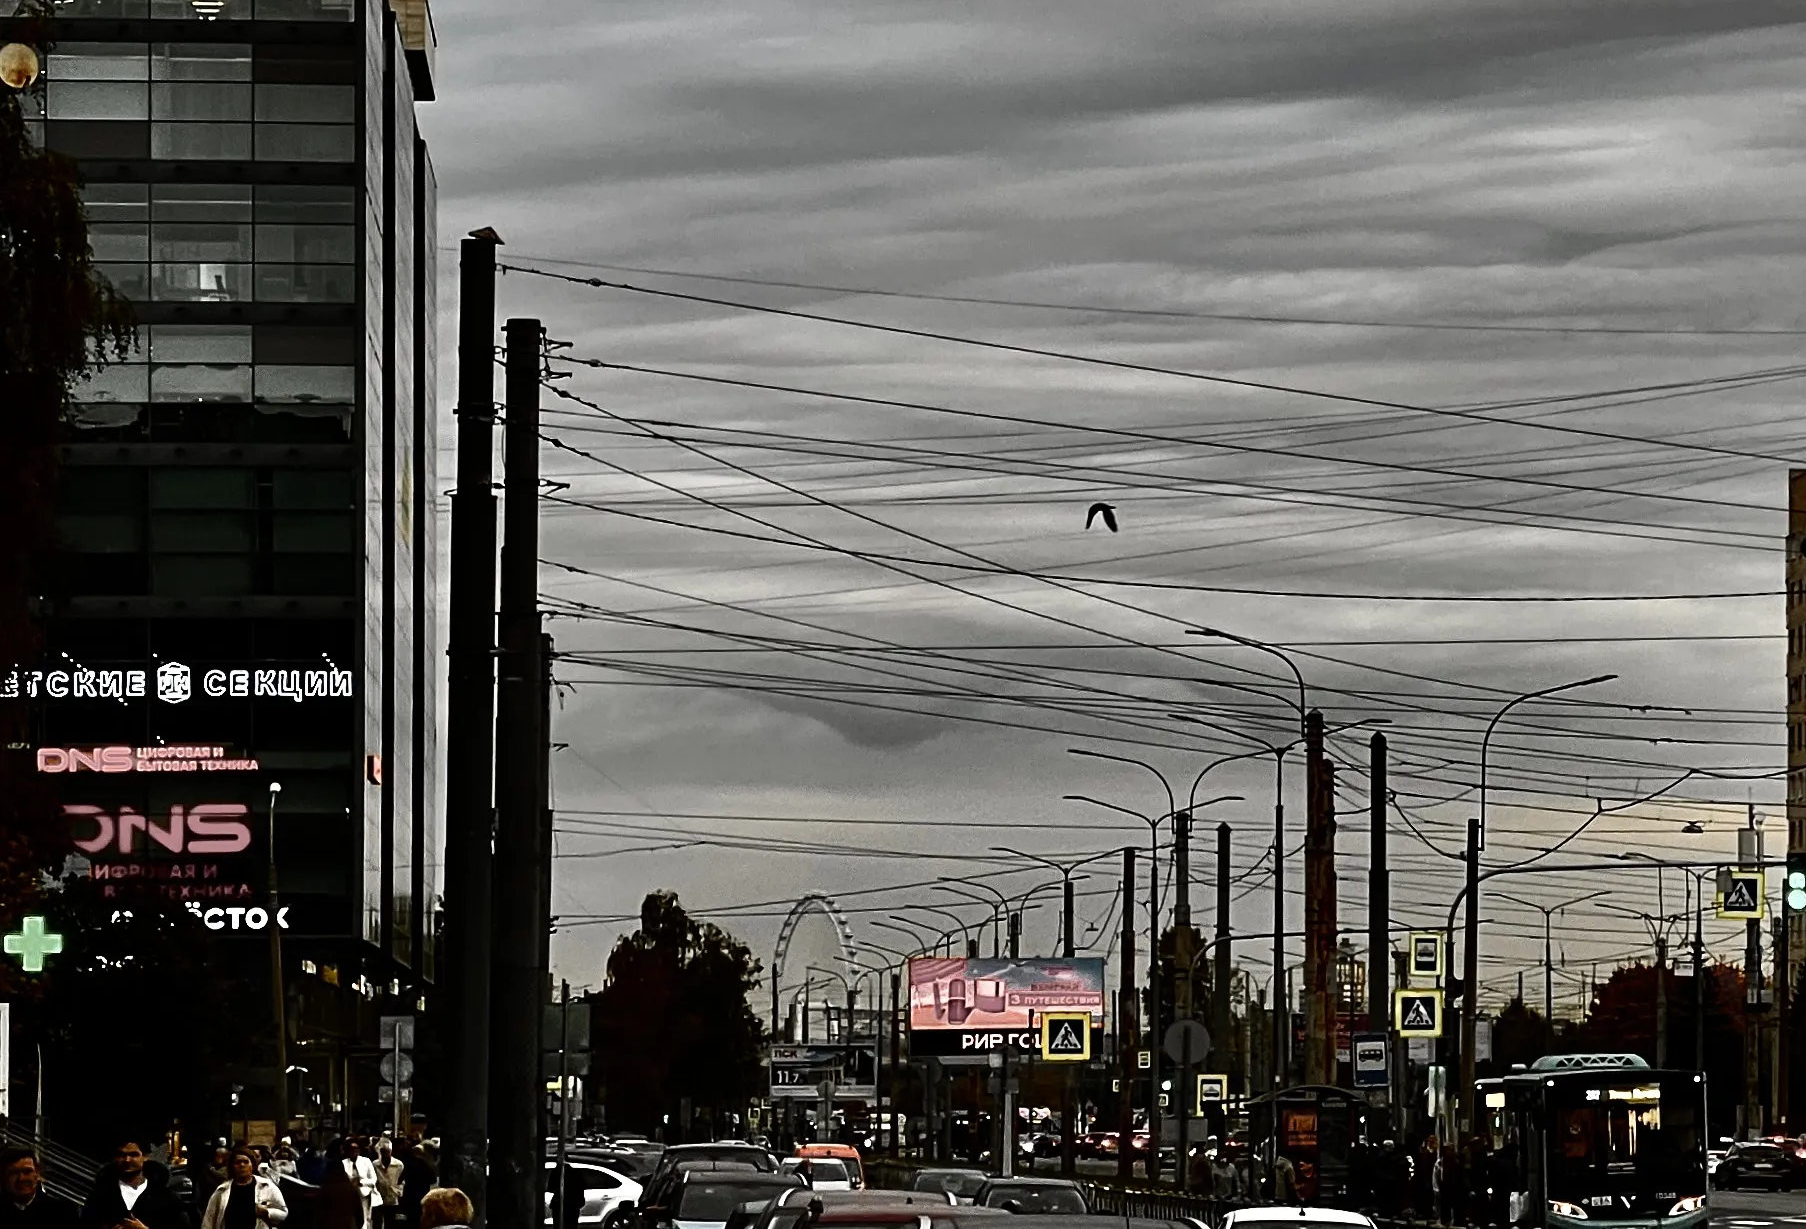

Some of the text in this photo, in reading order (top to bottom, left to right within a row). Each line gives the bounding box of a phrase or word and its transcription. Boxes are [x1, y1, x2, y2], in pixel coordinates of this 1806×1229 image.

[203, 669, 353, 703] СЕКЦИИ
[37, 746, 133, 773] DNS
[136, 747, 225, 759] ЦИФРОВАЯ И
[136, 759, 259, 772] БЫТОВАЯ ТЕХНИКА
[62, 804, 251, 854] DNS
[1011, 995, 1020, 1005] 3
